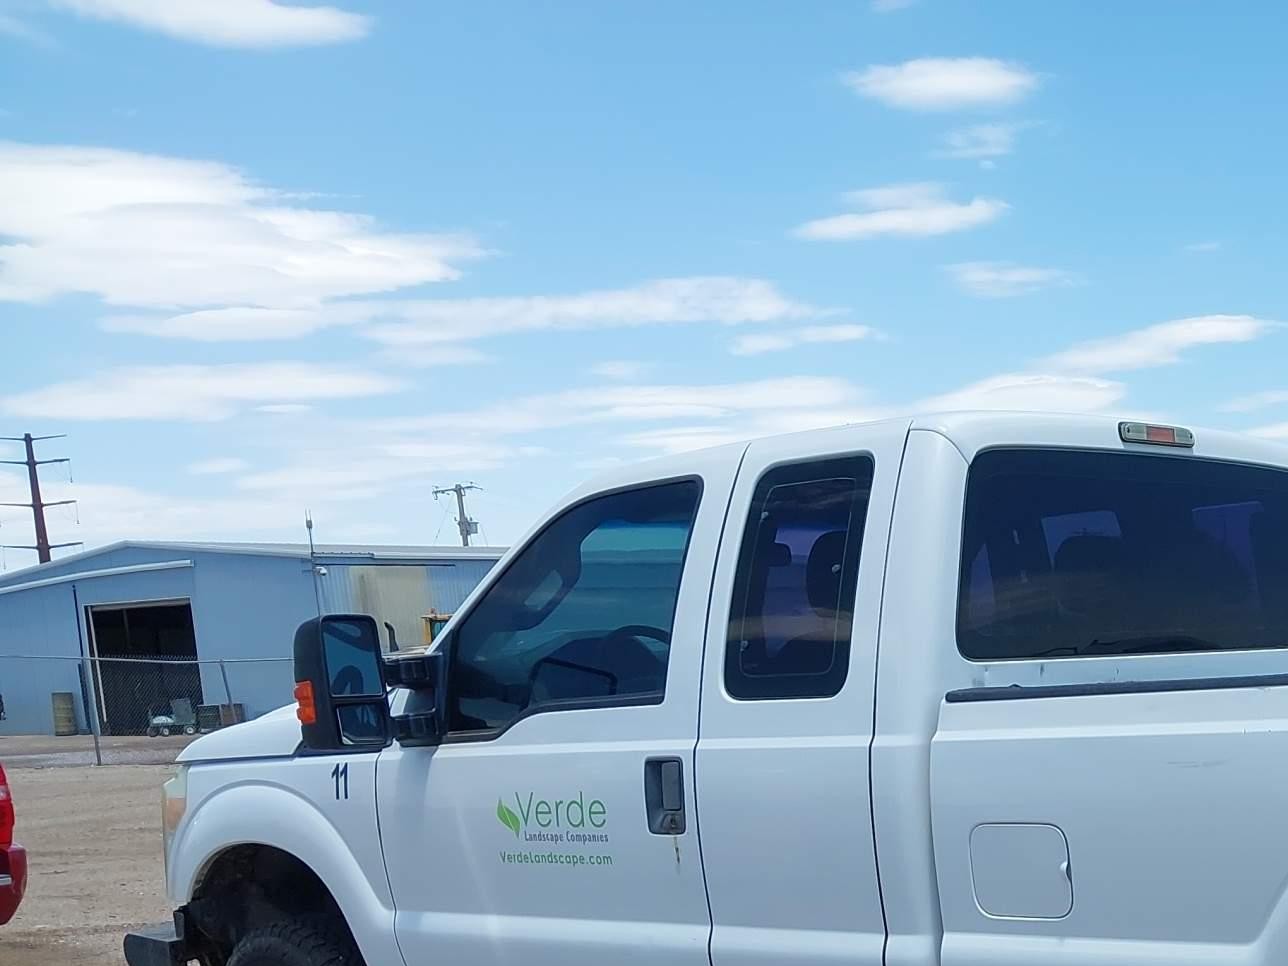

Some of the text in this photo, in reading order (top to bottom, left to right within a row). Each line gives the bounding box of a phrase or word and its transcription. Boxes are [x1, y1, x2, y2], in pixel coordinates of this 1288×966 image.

[331, 762, 349, 800] 11
[514, 790, 606, 828] Verde
[524, 831, 609, 845] Landscape Companies
